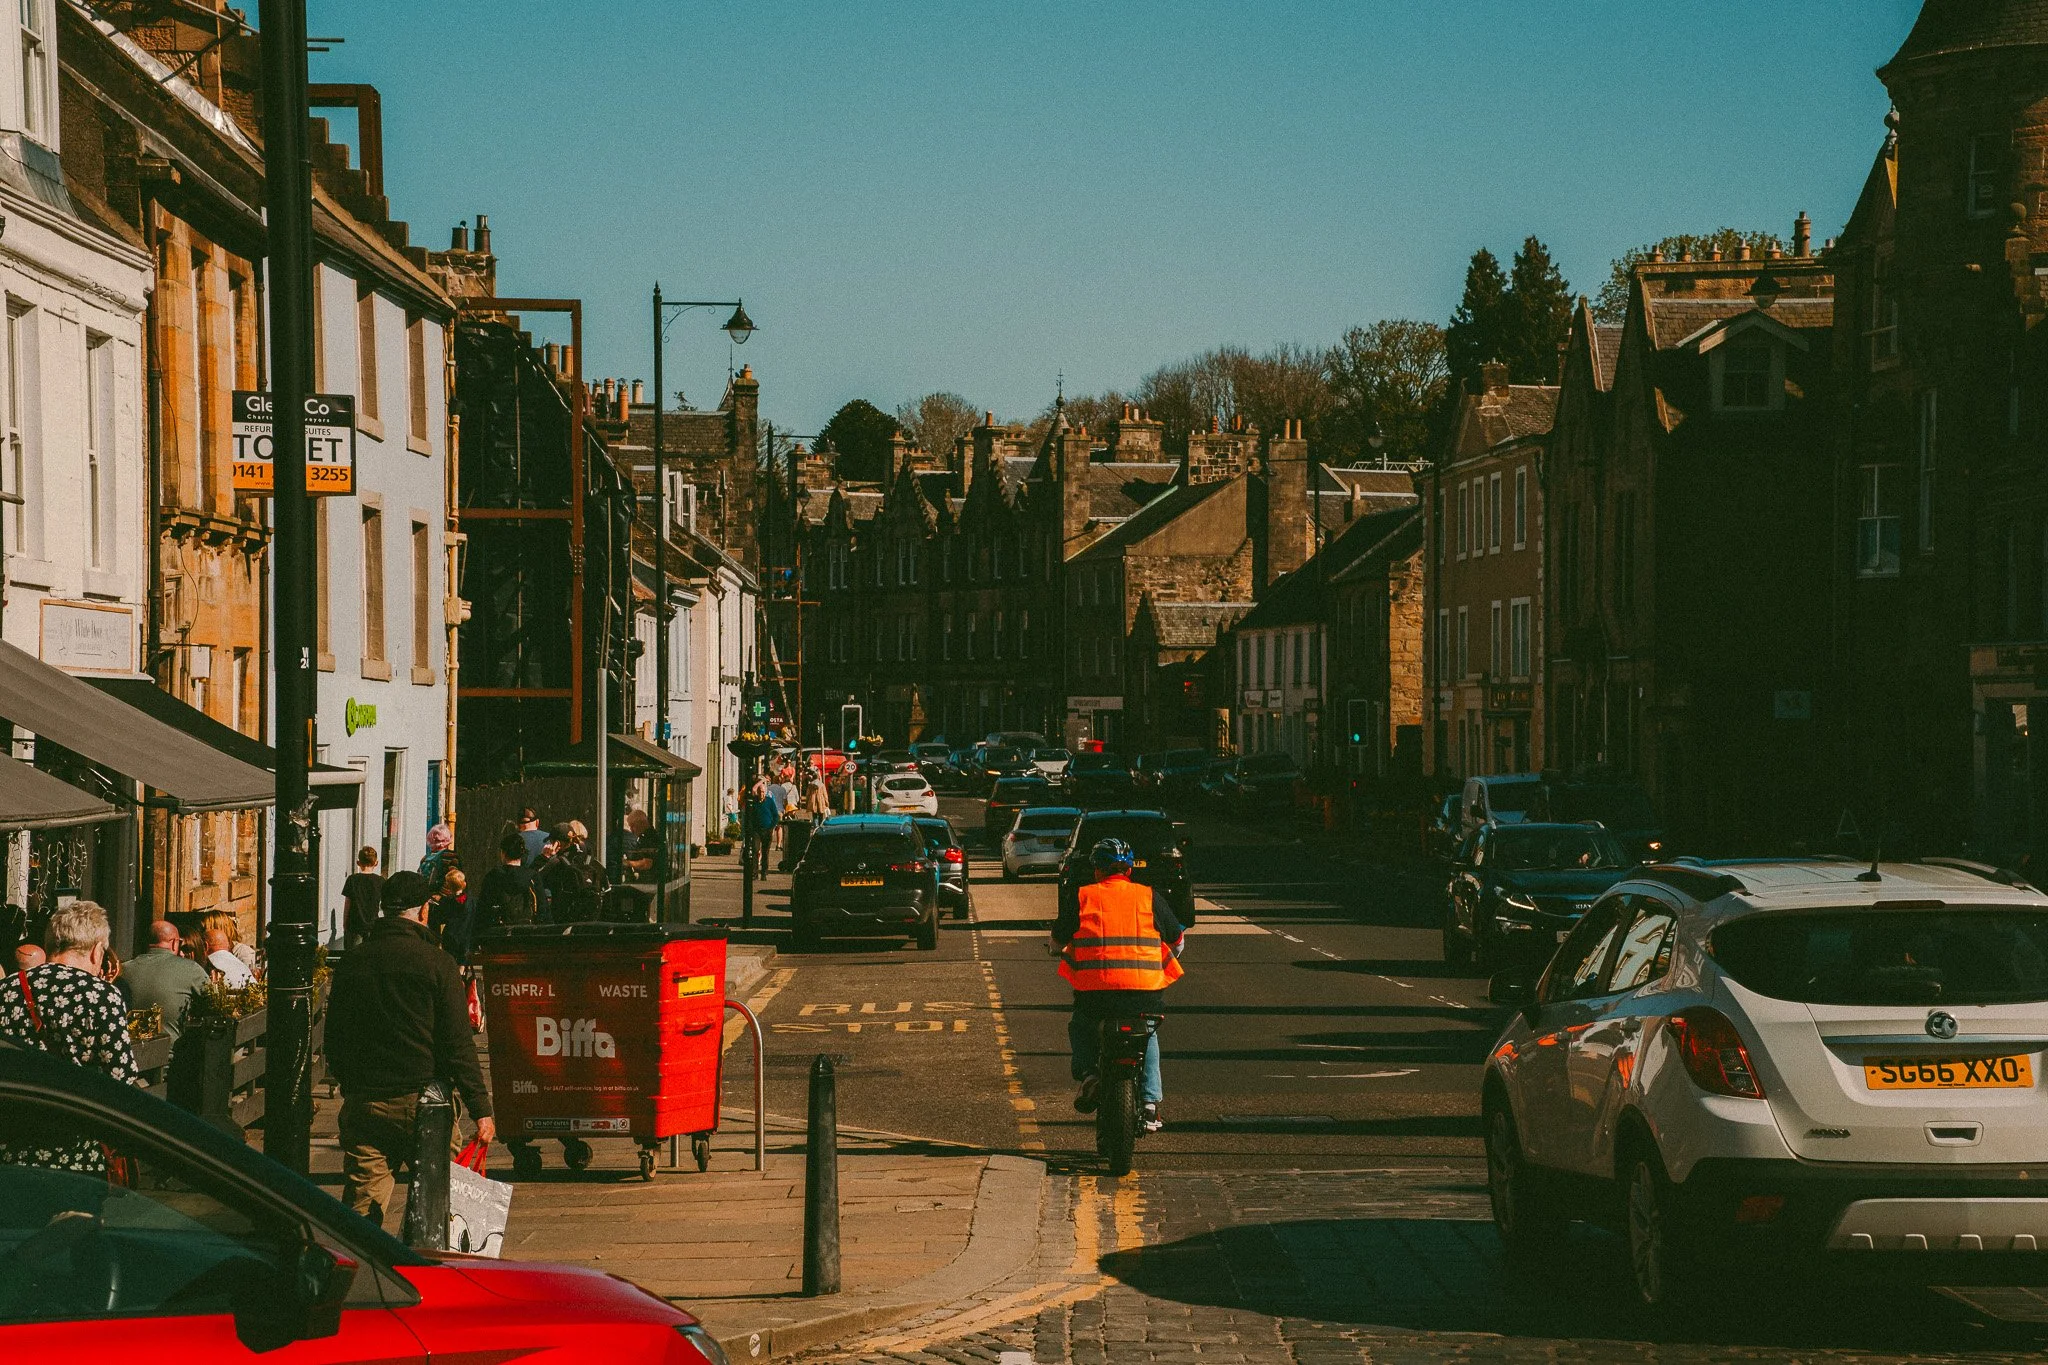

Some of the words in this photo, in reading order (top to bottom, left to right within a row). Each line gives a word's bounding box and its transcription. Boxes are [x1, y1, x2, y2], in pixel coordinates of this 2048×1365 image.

[245, 395, 273, 413] Gle
[304, 398, 330, 415] Co
[244, 425, 271, 433] REFUR
[233, 433, 273, 460] TO
[308, 437, 343, 463] ET
[311, 467, 348, 481] 3255
[599, 984, 648, 998] WASTE
[535, 1016, 616, 1058] Biffa
[1879, 1059, 1955, 1083] SG66
[1964, 1058, 2019, 1083] XXO
[512, 1080, 539, 1094] Biffa
